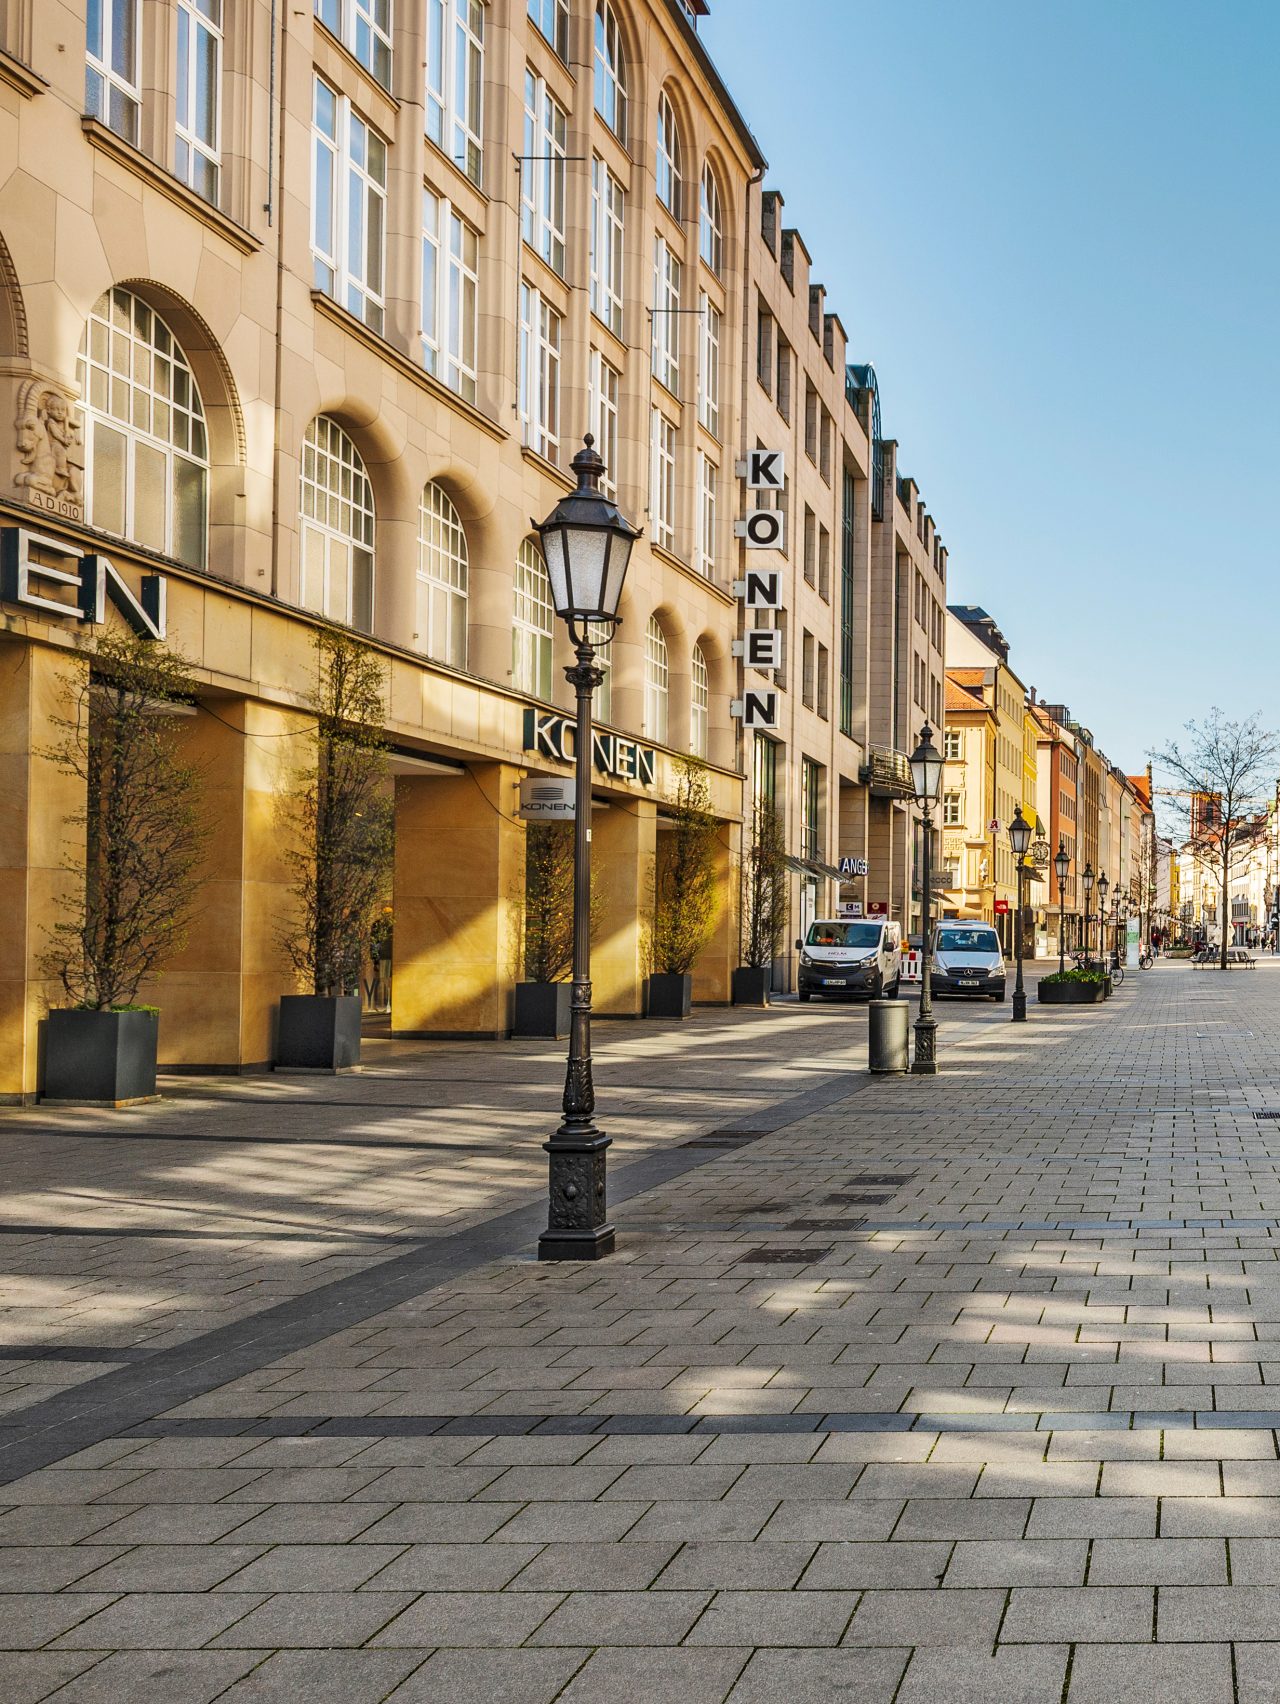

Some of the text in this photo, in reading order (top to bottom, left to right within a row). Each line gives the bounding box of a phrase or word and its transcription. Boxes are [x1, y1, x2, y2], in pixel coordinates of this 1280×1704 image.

[58, 503, 79, 519] 1910
[746, 453, 780, 725] KONEN
[524, 708, 656, 785] KONEN
[521, 803, 576, 811] KONEN
